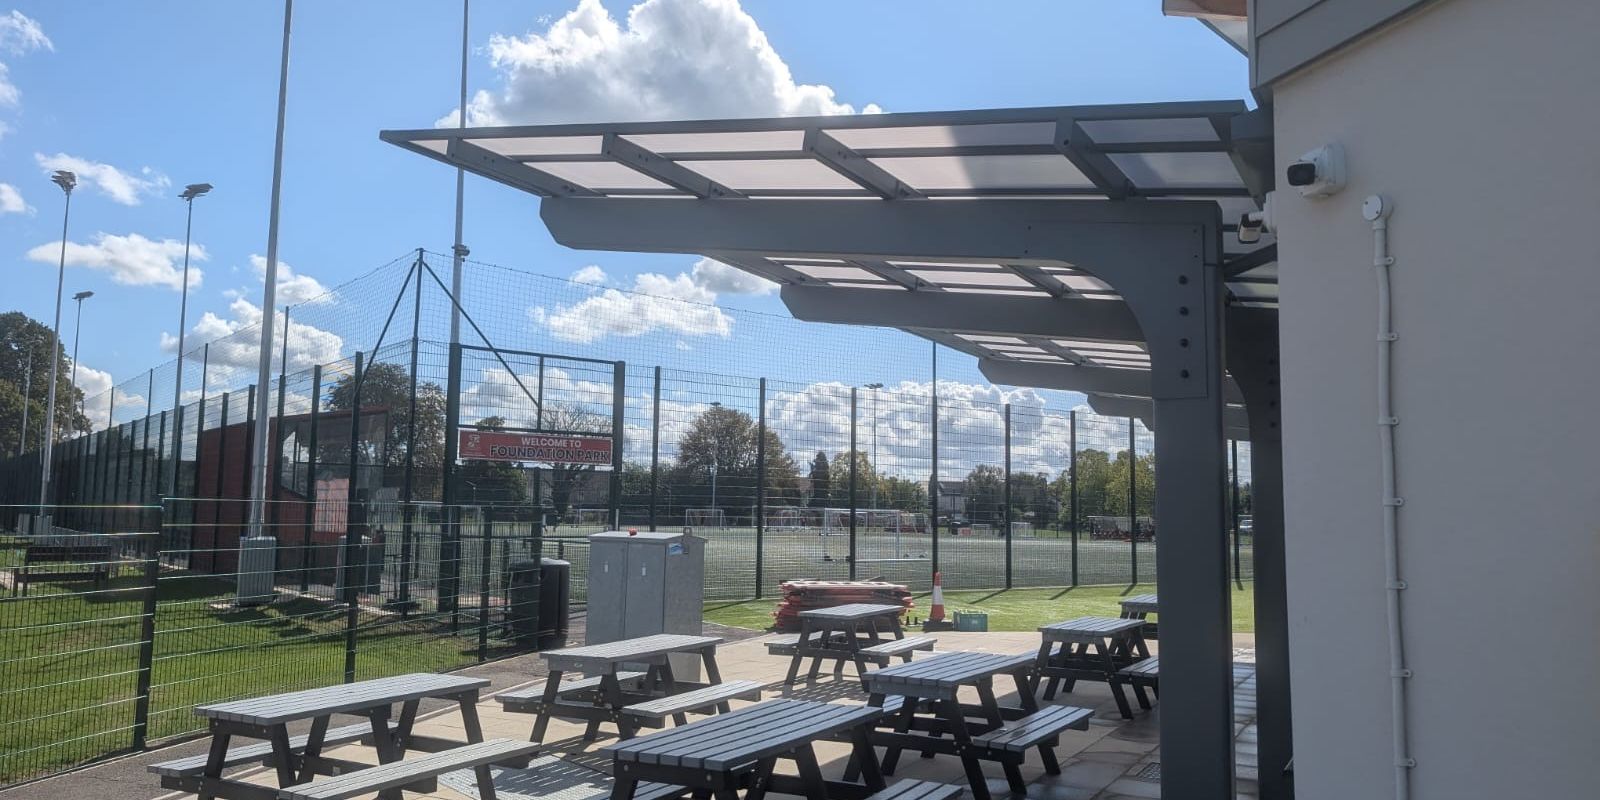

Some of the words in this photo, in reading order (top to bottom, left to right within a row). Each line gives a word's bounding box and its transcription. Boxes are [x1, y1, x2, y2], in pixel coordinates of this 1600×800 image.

[521, 437, 568, 447] WELCOME
[570, 439, 582, 448] TO
[490, 445, 575, 460] FOUNDATION
[576, 450, 610, 462] PARK
